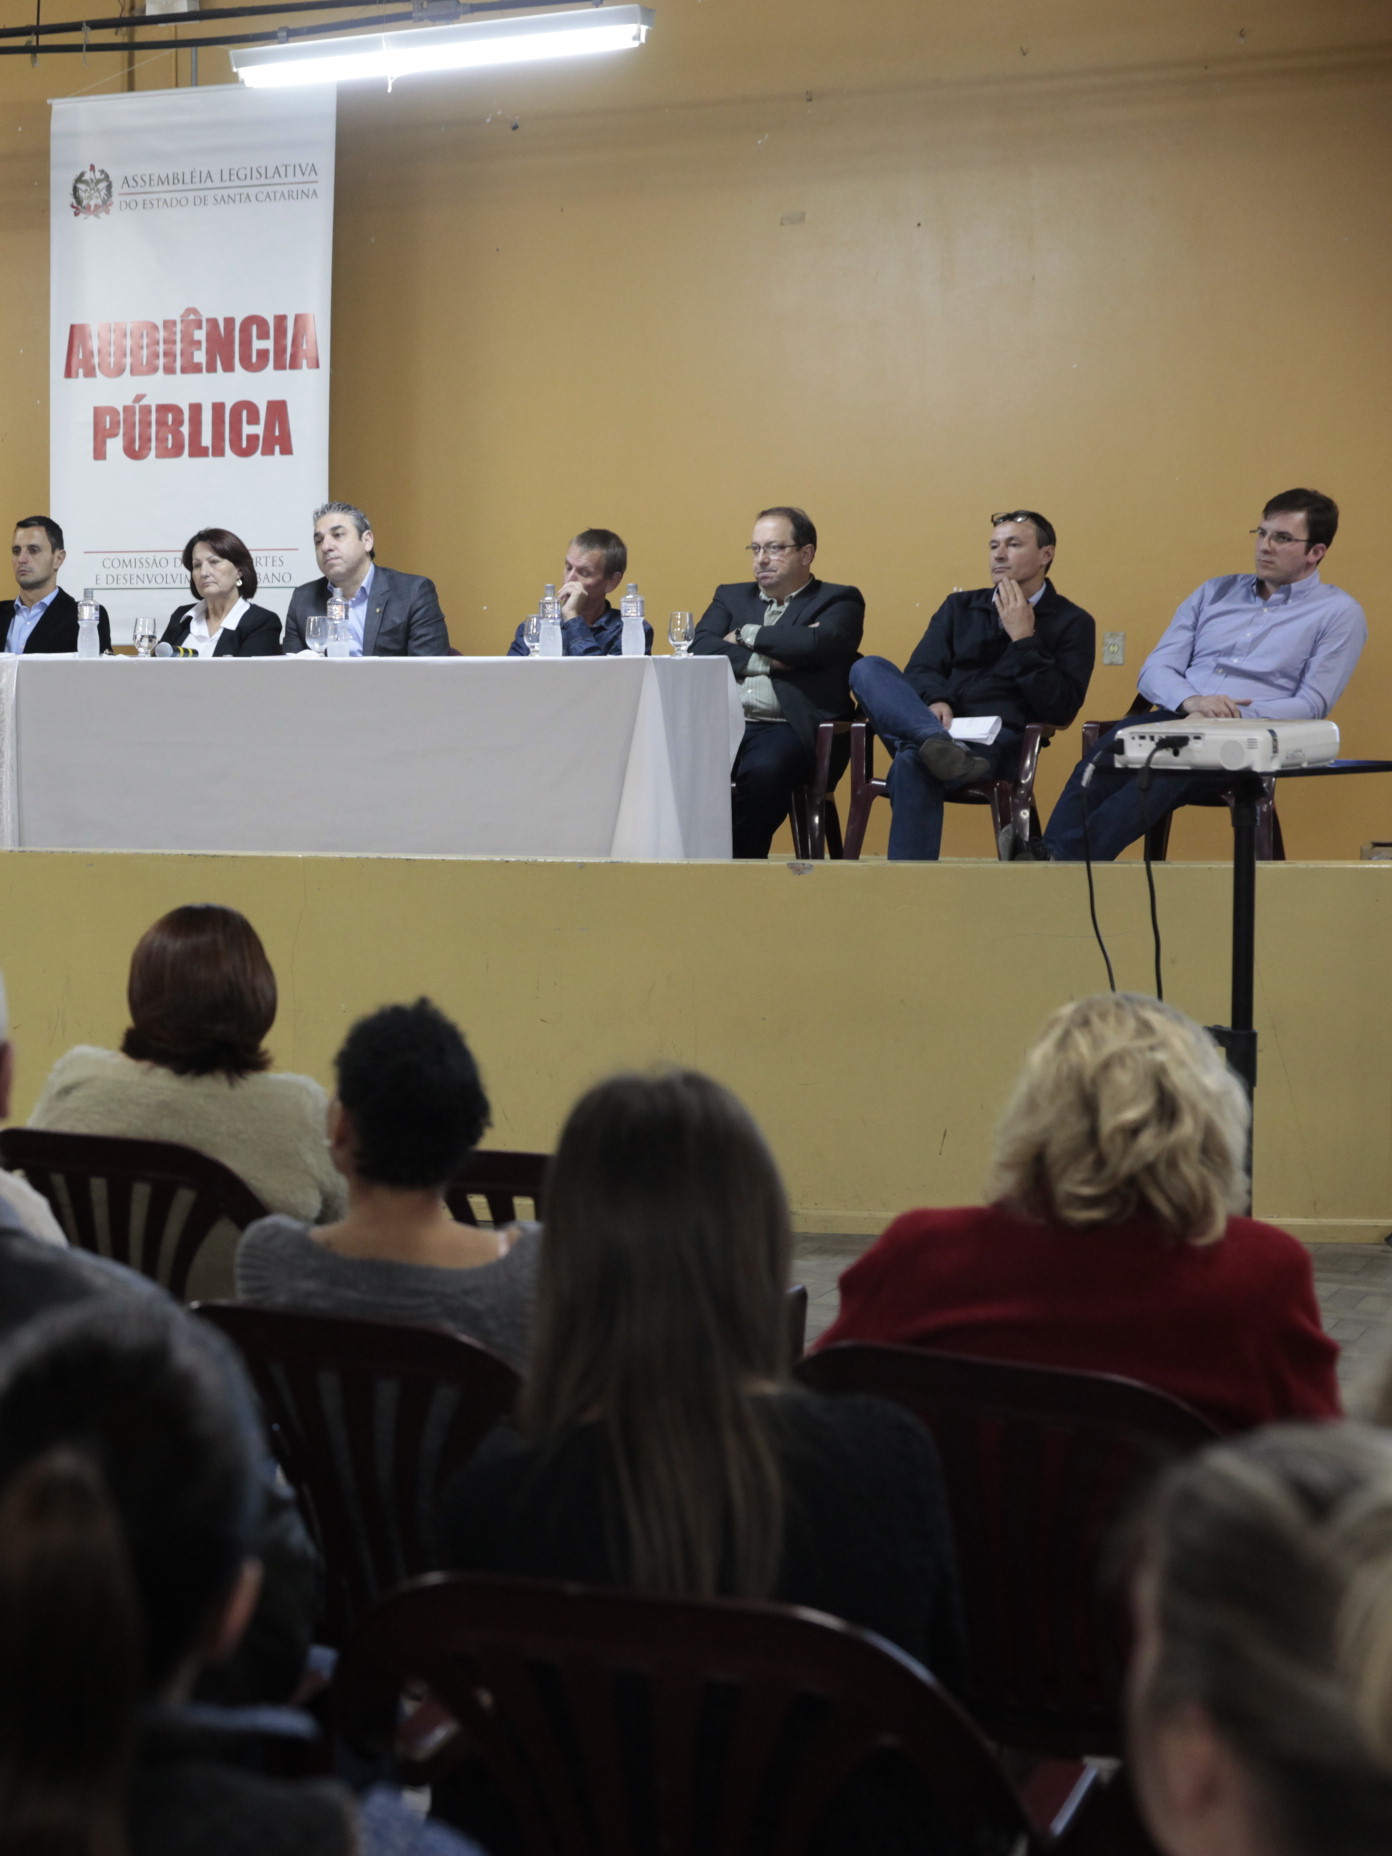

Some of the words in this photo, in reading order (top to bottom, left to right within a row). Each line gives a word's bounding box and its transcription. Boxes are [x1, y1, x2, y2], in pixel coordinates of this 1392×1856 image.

[120, 168, 214, 189] ASSEMBLÉIA
[220, 163, 319, 183] LEGISLATIVA
[119, 199, 138, 211] DO
[142, 195, 189, 209] ESTADO
[193, 195, 208, 207] DE
[212, 192, 252, 206] SANTA
[255, 188, 319, 203] CATARINA
[63, 307, 320, 379] AUDIÊNCIA
[93, 393, 294, 461] PÚBLICA
[102, 555, 169, 569] COMISSÃO
[95, 575, 101, 585] E
[106, 572, 190, 585] DESENVOLVIM
[257, 572, 292, 584] BANO
